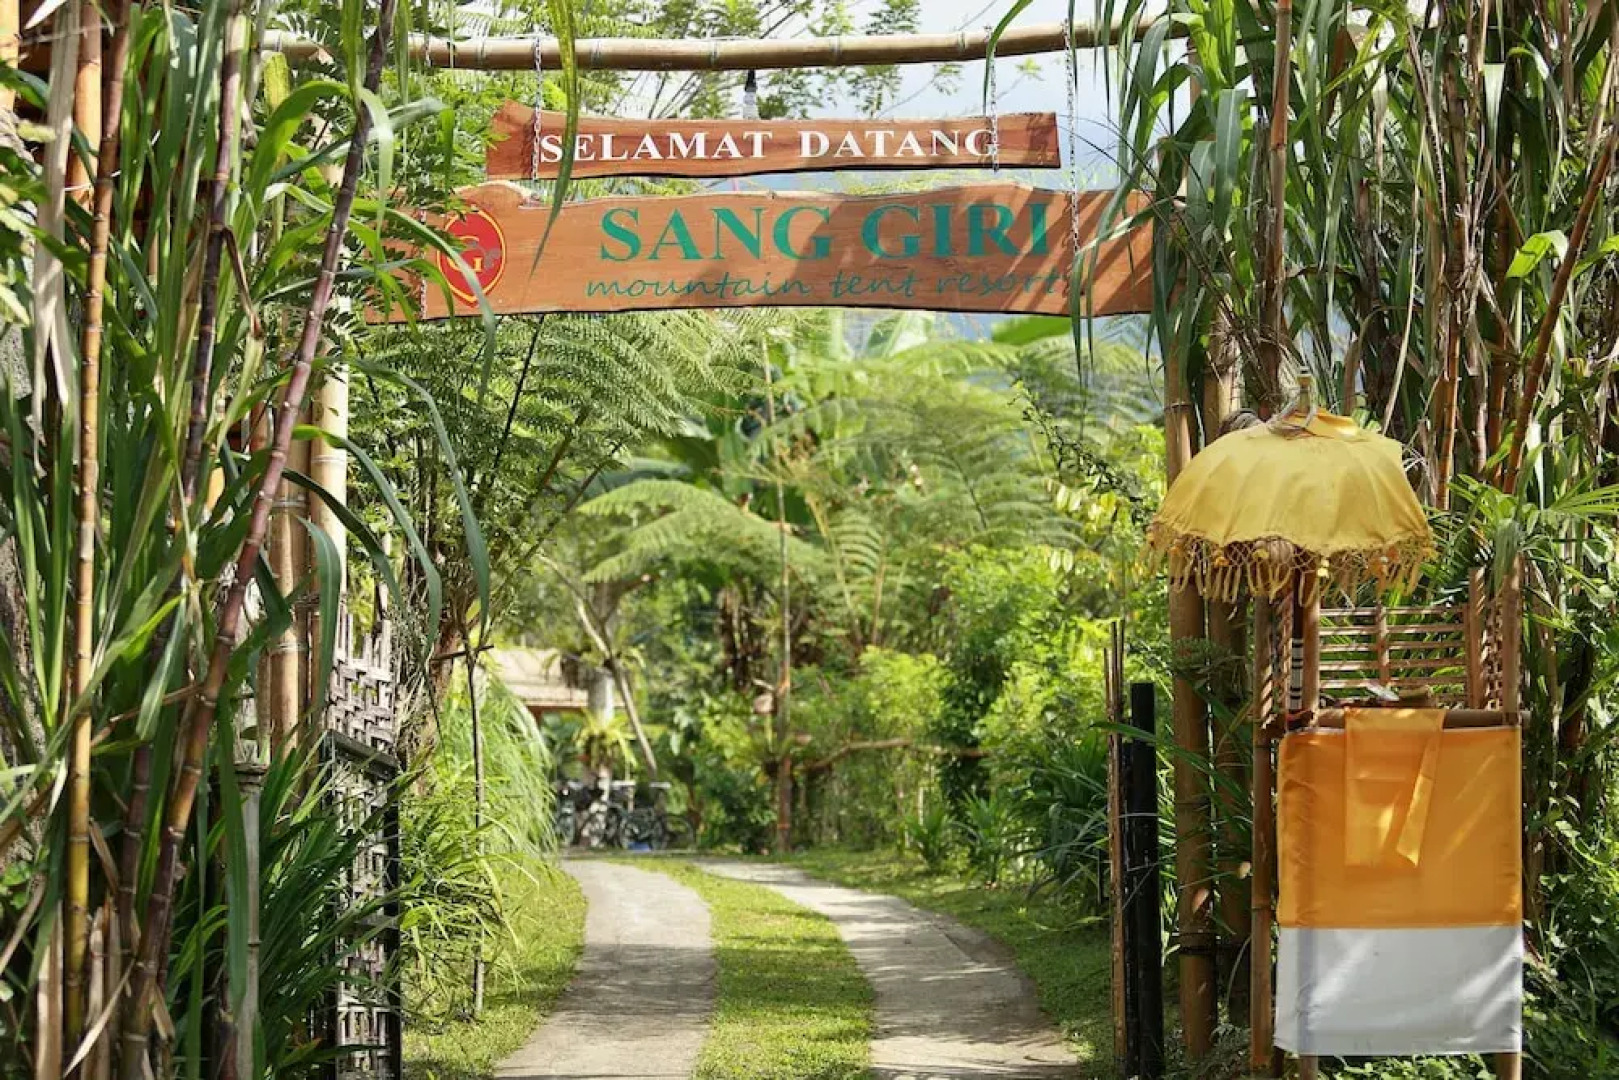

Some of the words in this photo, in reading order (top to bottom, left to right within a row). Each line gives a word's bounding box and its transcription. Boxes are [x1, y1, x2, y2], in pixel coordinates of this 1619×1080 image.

[540, 130, 773, 163] SELAMAT
[799, 128, 1000, 158] DATANG
[601, 207, 831, 261] SANG
[862, 203, 1050, 259] GIRI
[586, 271, 811, 297] mountain
[831, 270, 920, 296] tent
[936, 266, 1061, 296] resort
